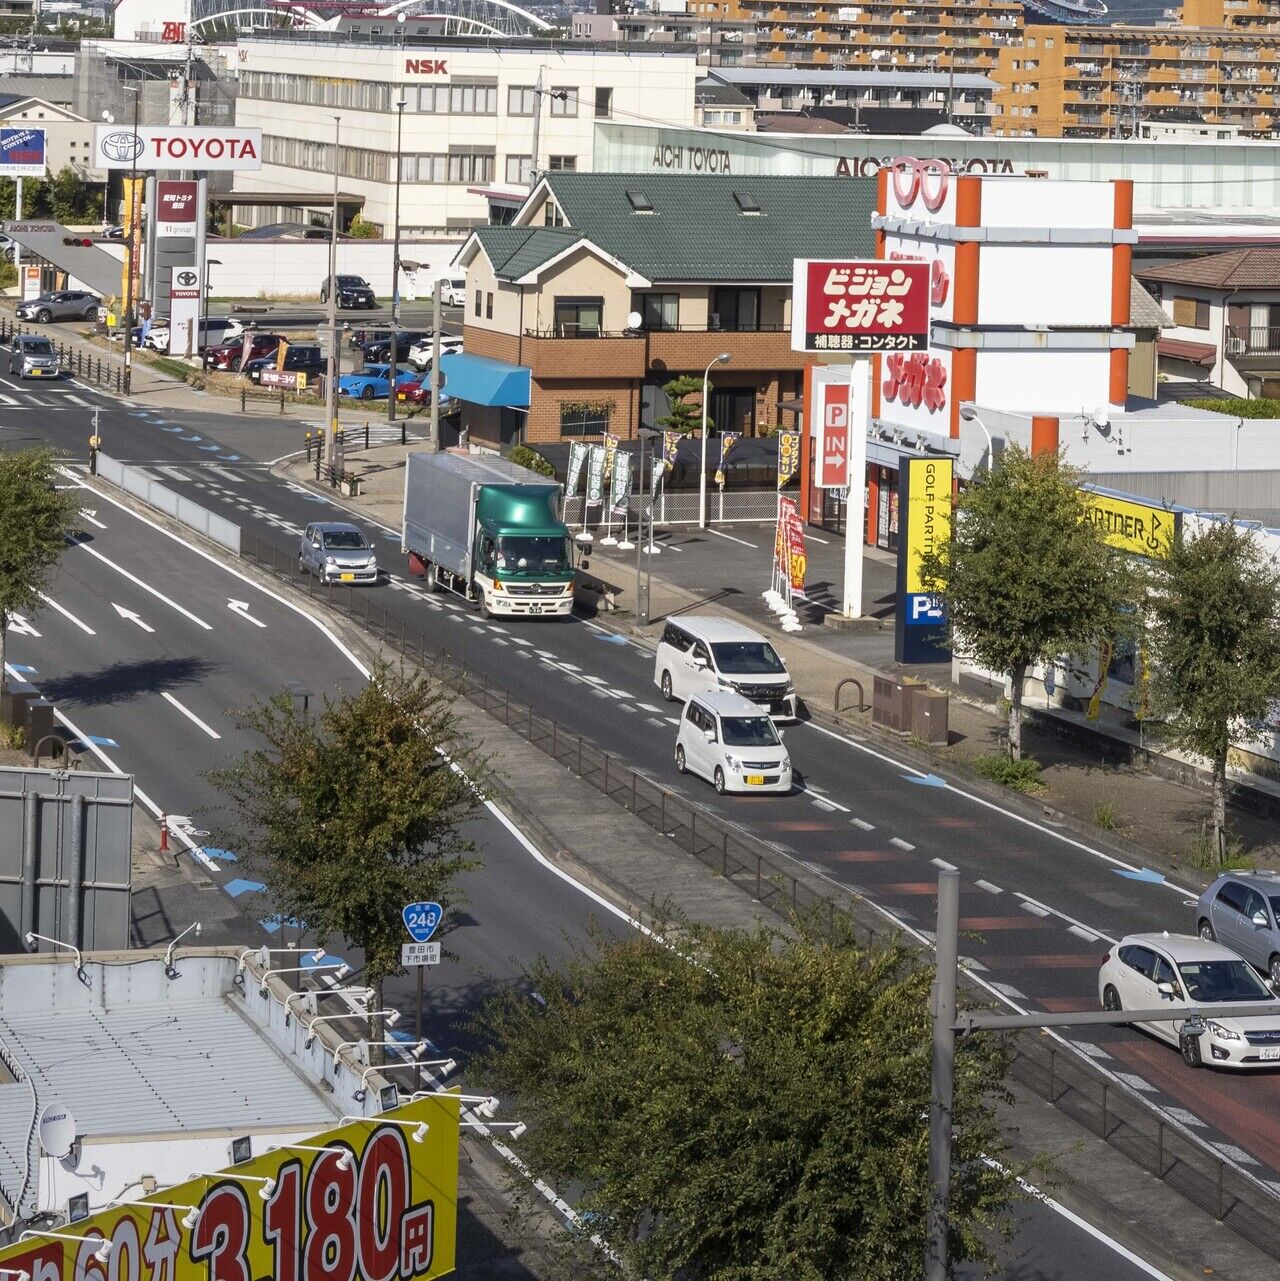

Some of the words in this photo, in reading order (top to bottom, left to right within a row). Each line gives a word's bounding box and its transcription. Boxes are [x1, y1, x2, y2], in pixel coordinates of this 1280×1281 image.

[405, 59, 448, 75] NSK
[150, 137, 257, 159] TOYOTA
[652, 145, 683, 168] AICHI
[688, 147, 732, 174] TOYOTA
[823, 267, 913, 297] ビジョン
[823, 298, 905, 329] メガネ
[814, 334, 918, 350] 補聴器・コンタクト
[831, 407, 843, 420] P
[825, 436, 845, 452] IN
[925, 463, 936, 503] GOLF
[913, 596, 930, 619] P
[408, 911, 436, 928] 248
[408, 945, 434, 954] 豊田市
[191, 1122, 434, 1281] 3180円
